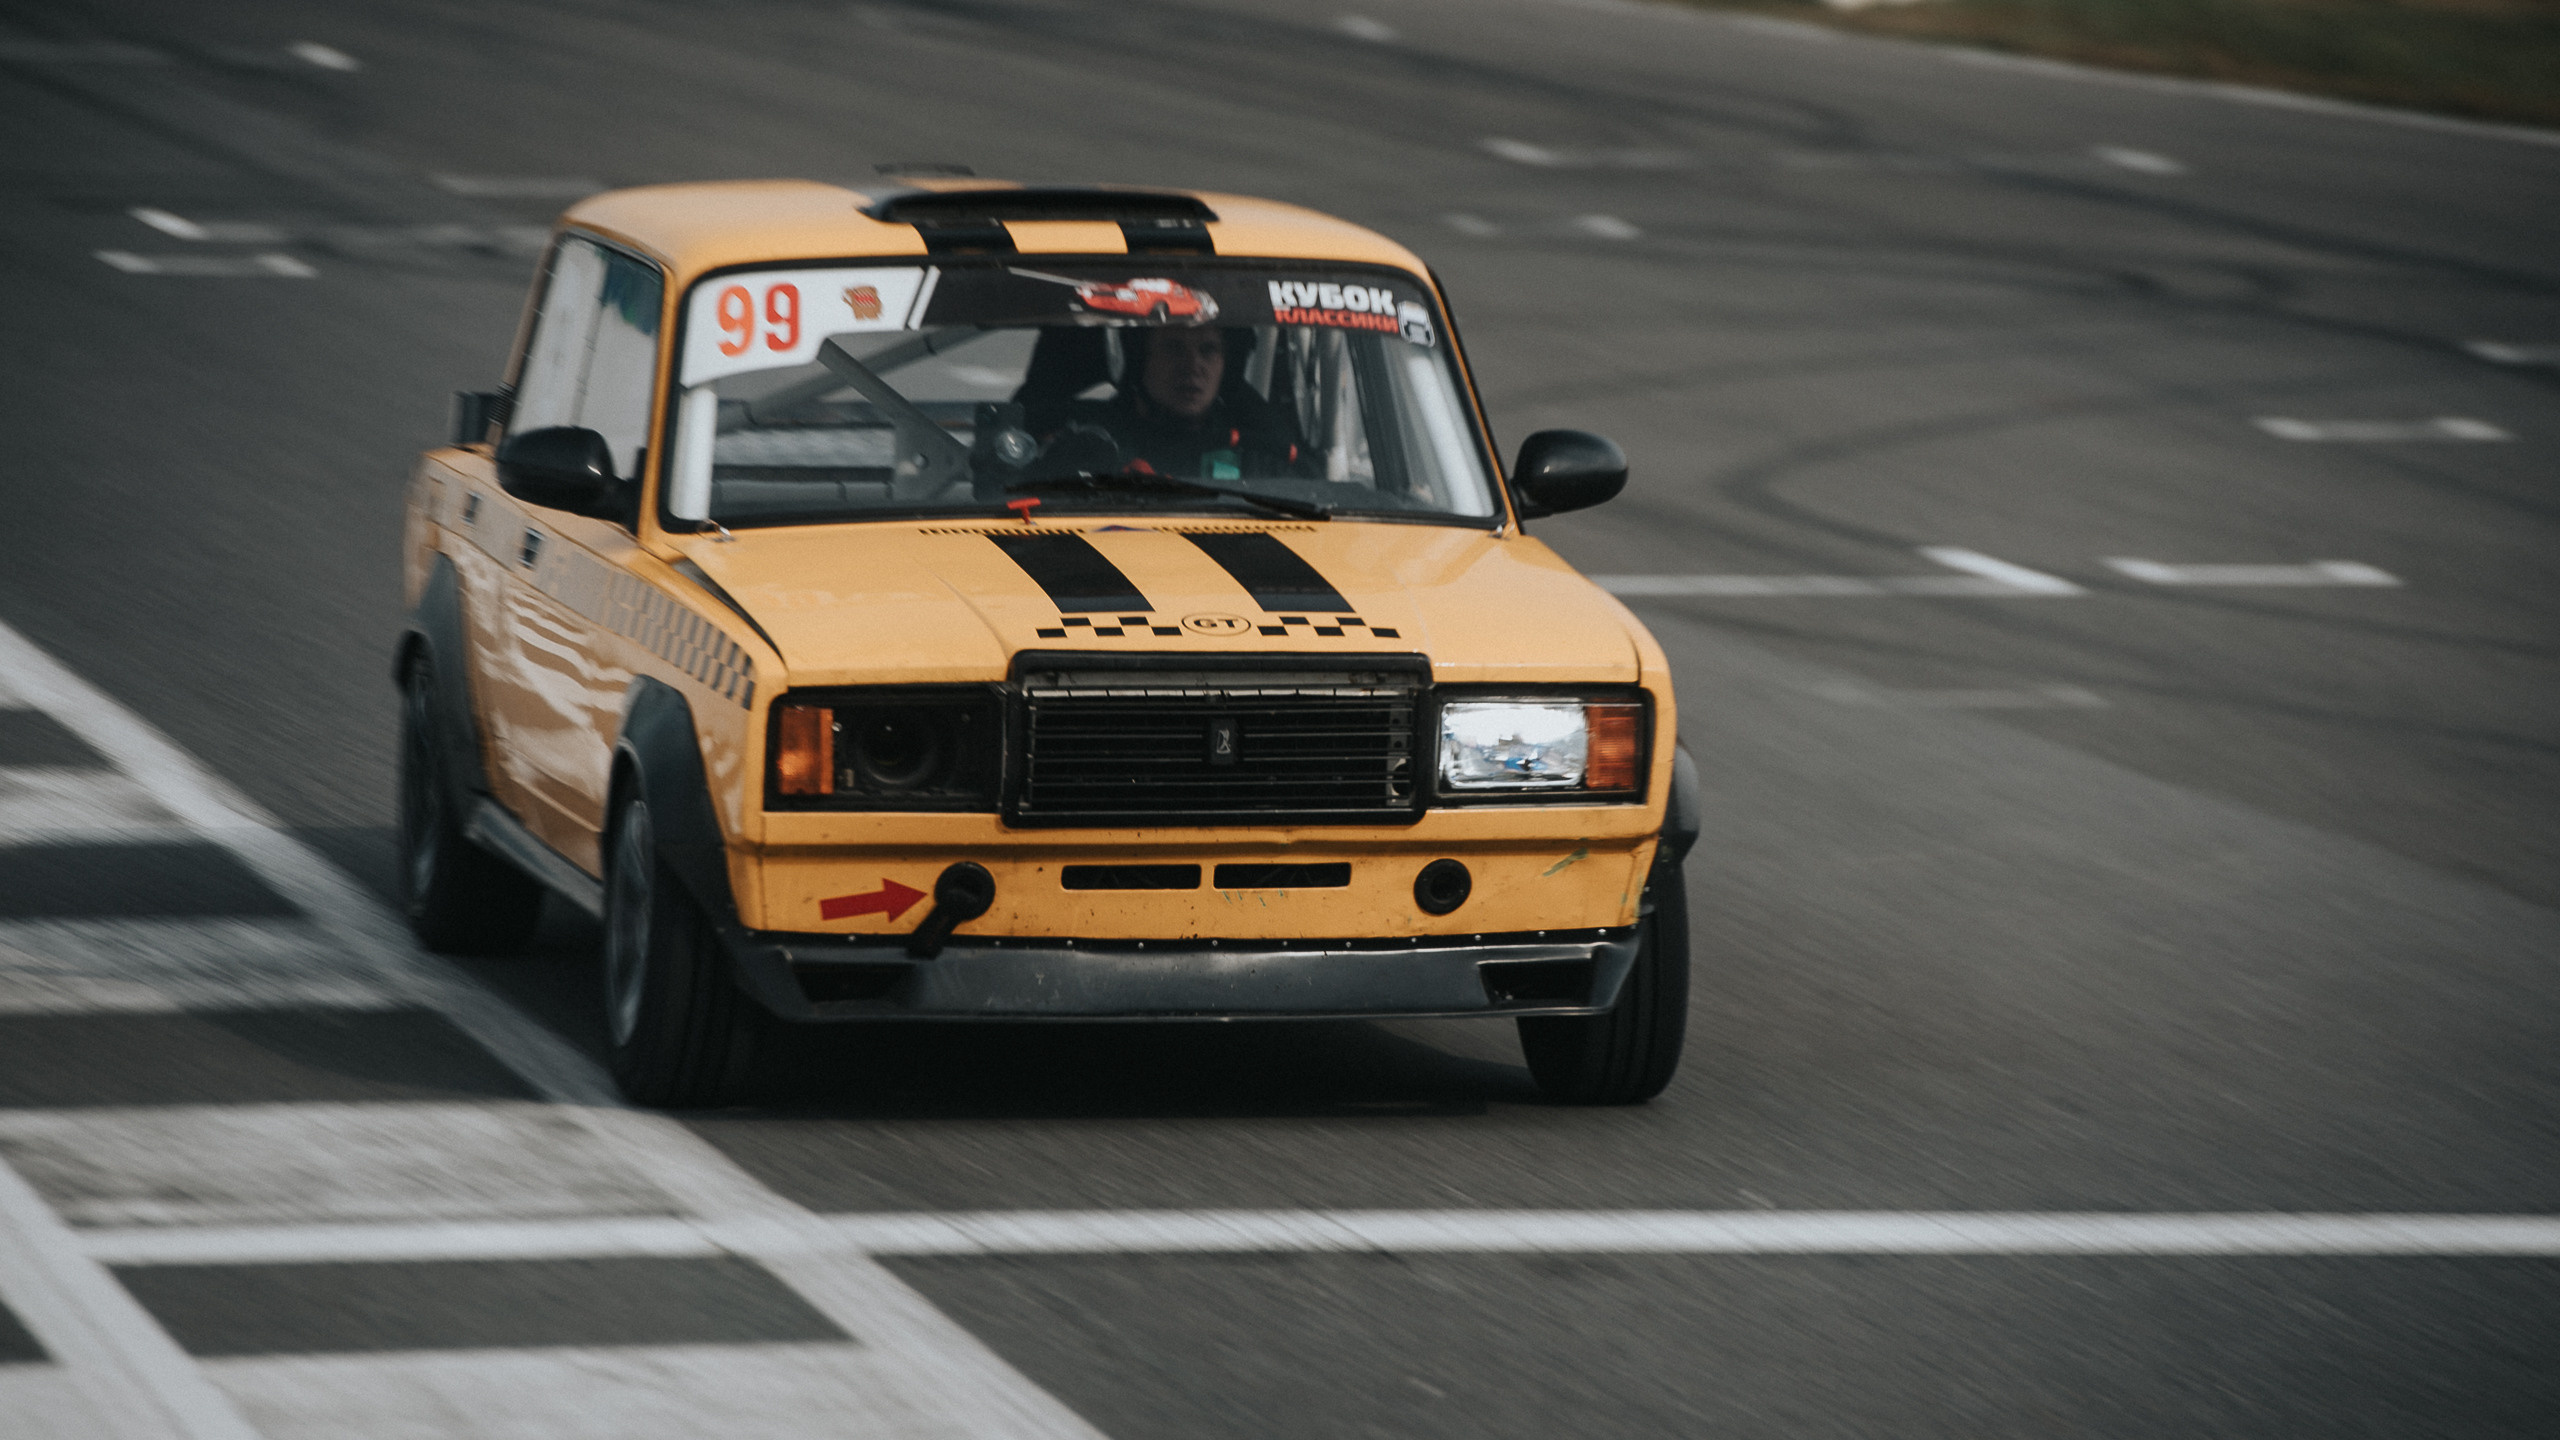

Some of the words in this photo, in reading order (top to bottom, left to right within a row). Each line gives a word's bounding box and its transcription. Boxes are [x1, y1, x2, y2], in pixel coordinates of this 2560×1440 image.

[1268, 280, 1397, 316] КУБОК
[717, 283, 799, 357] 99
[1274, 307, 1399, 334] КЛАССИКИ
[1193, 618, 1239, 628] GT
